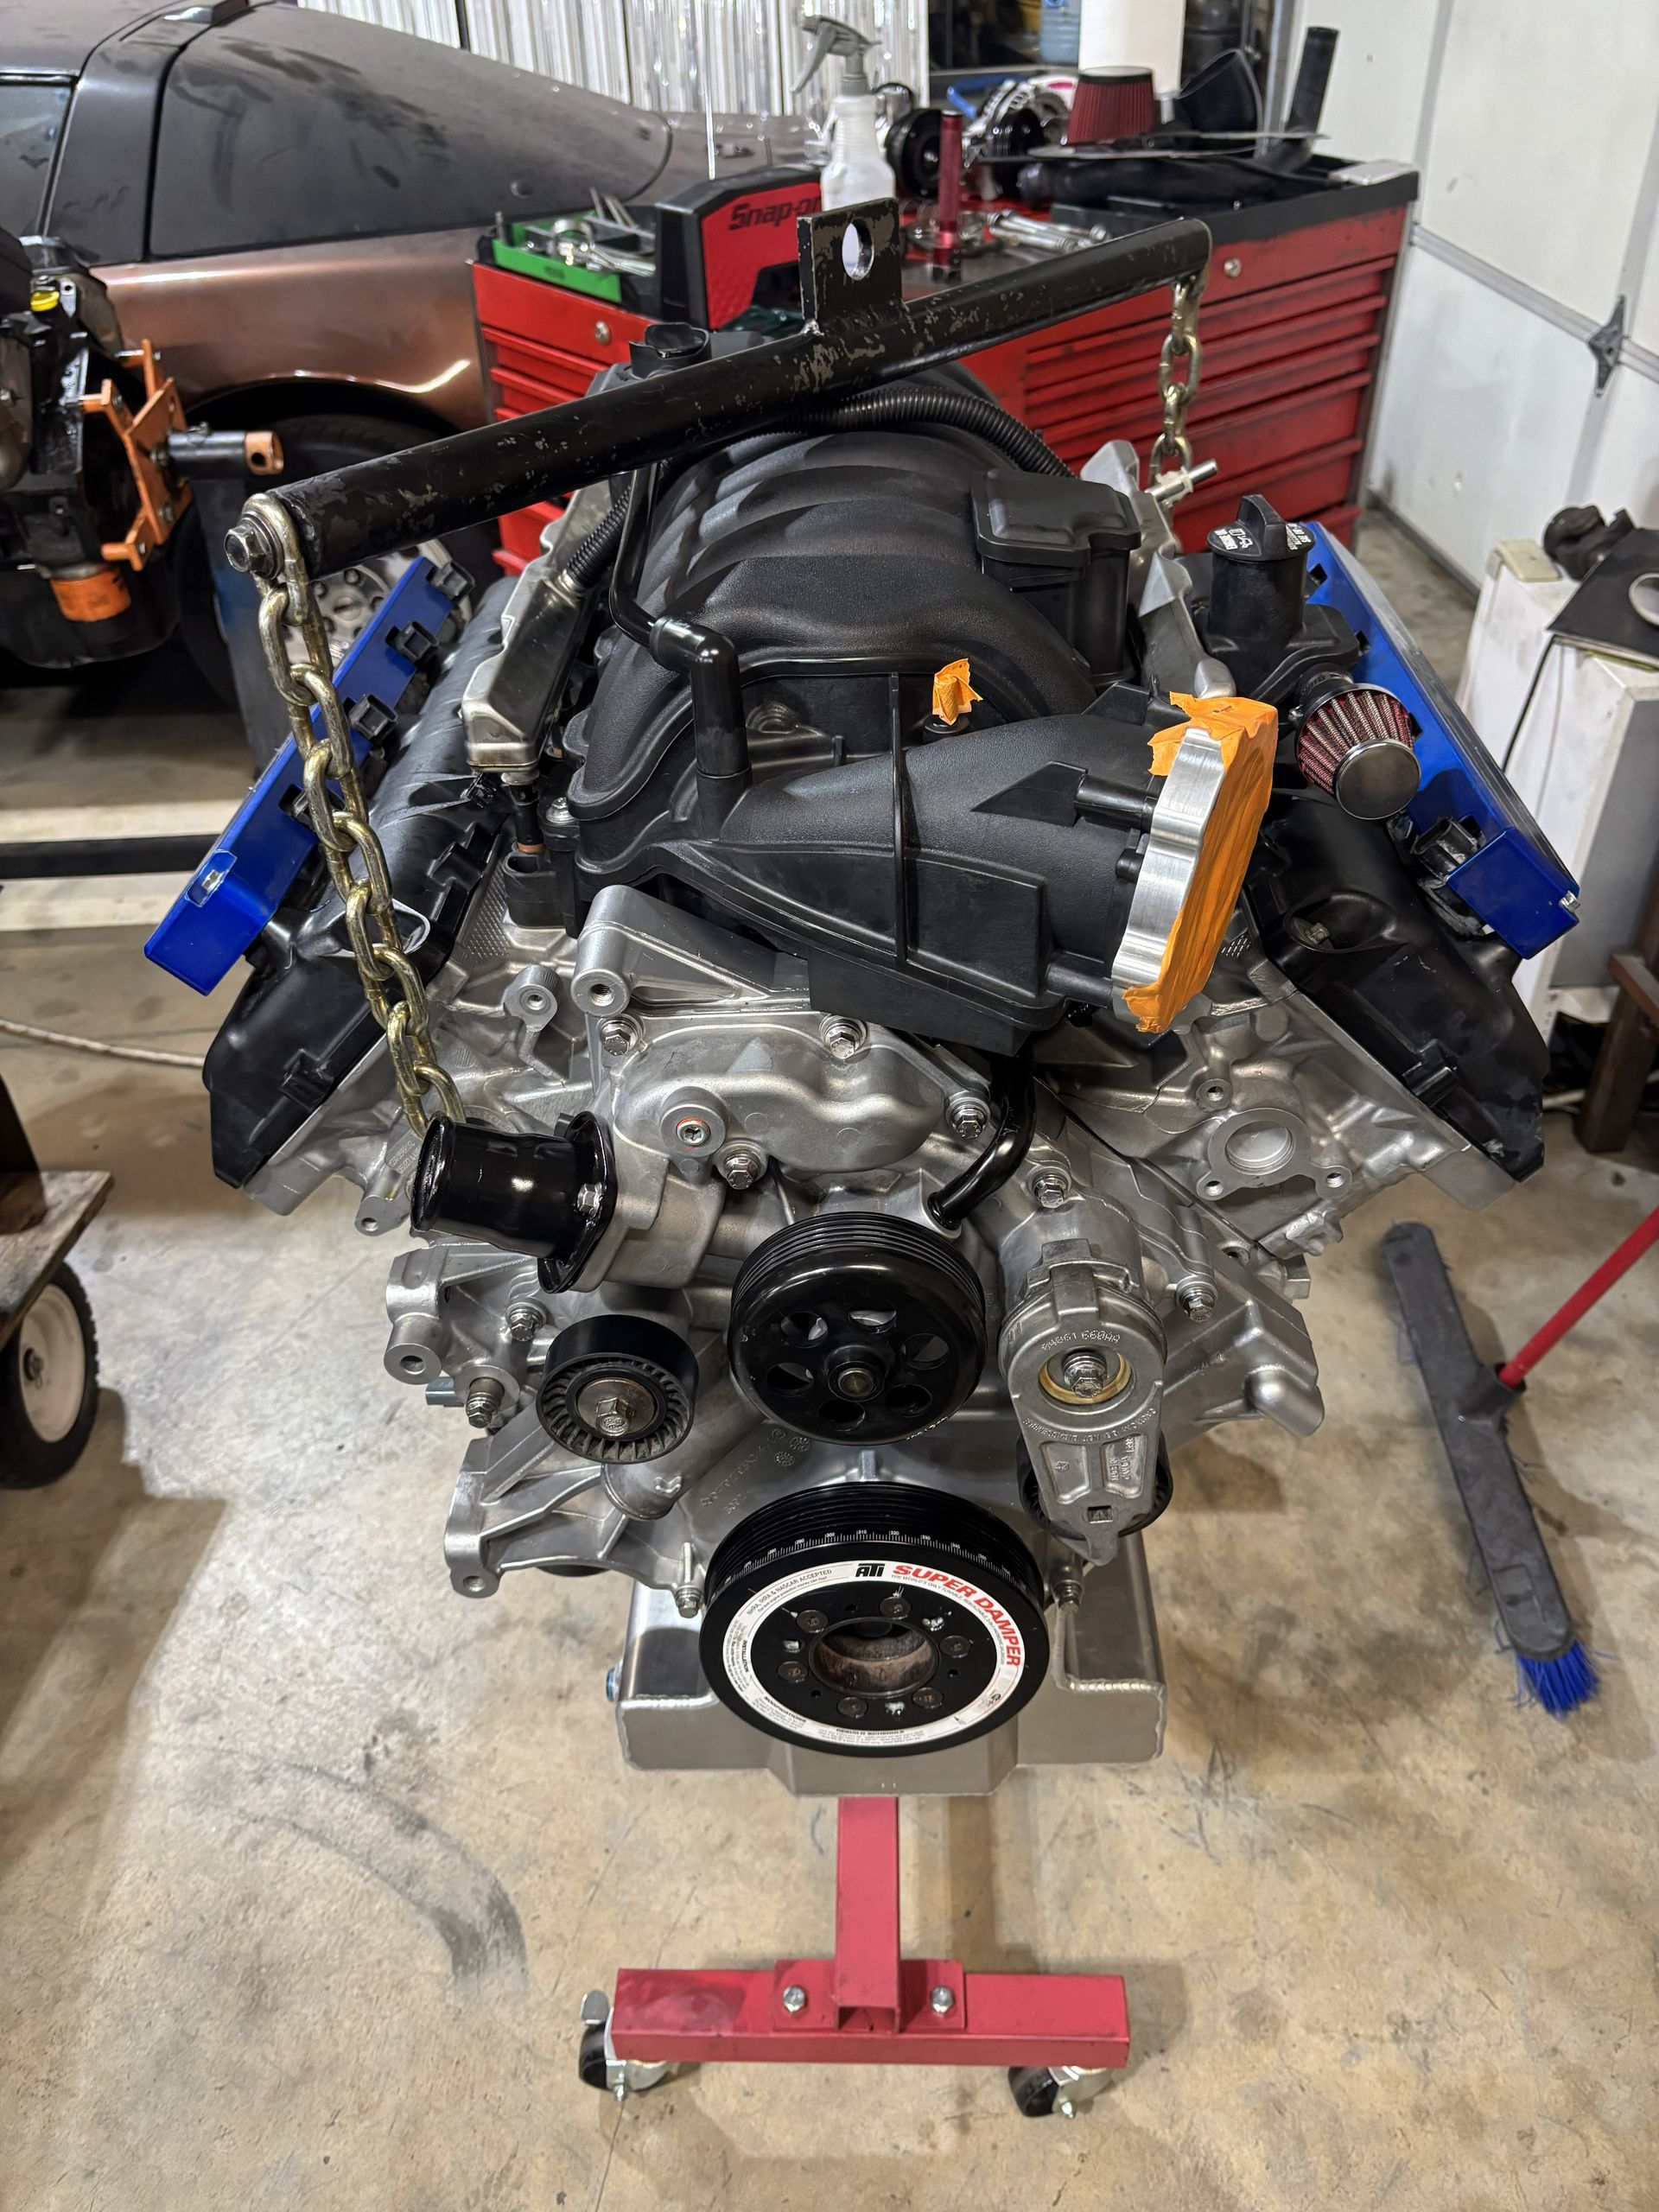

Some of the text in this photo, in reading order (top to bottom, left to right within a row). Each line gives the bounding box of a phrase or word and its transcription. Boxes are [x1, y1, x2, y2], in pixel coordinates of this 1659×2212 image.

[799, 1569, 832, 1583] ACCEPTED
[855, 1562, 886, 1578] ATI
[893, 1564, 978, 1598] SUPER
[974, 1597, 1021, 1667] DAMPER
